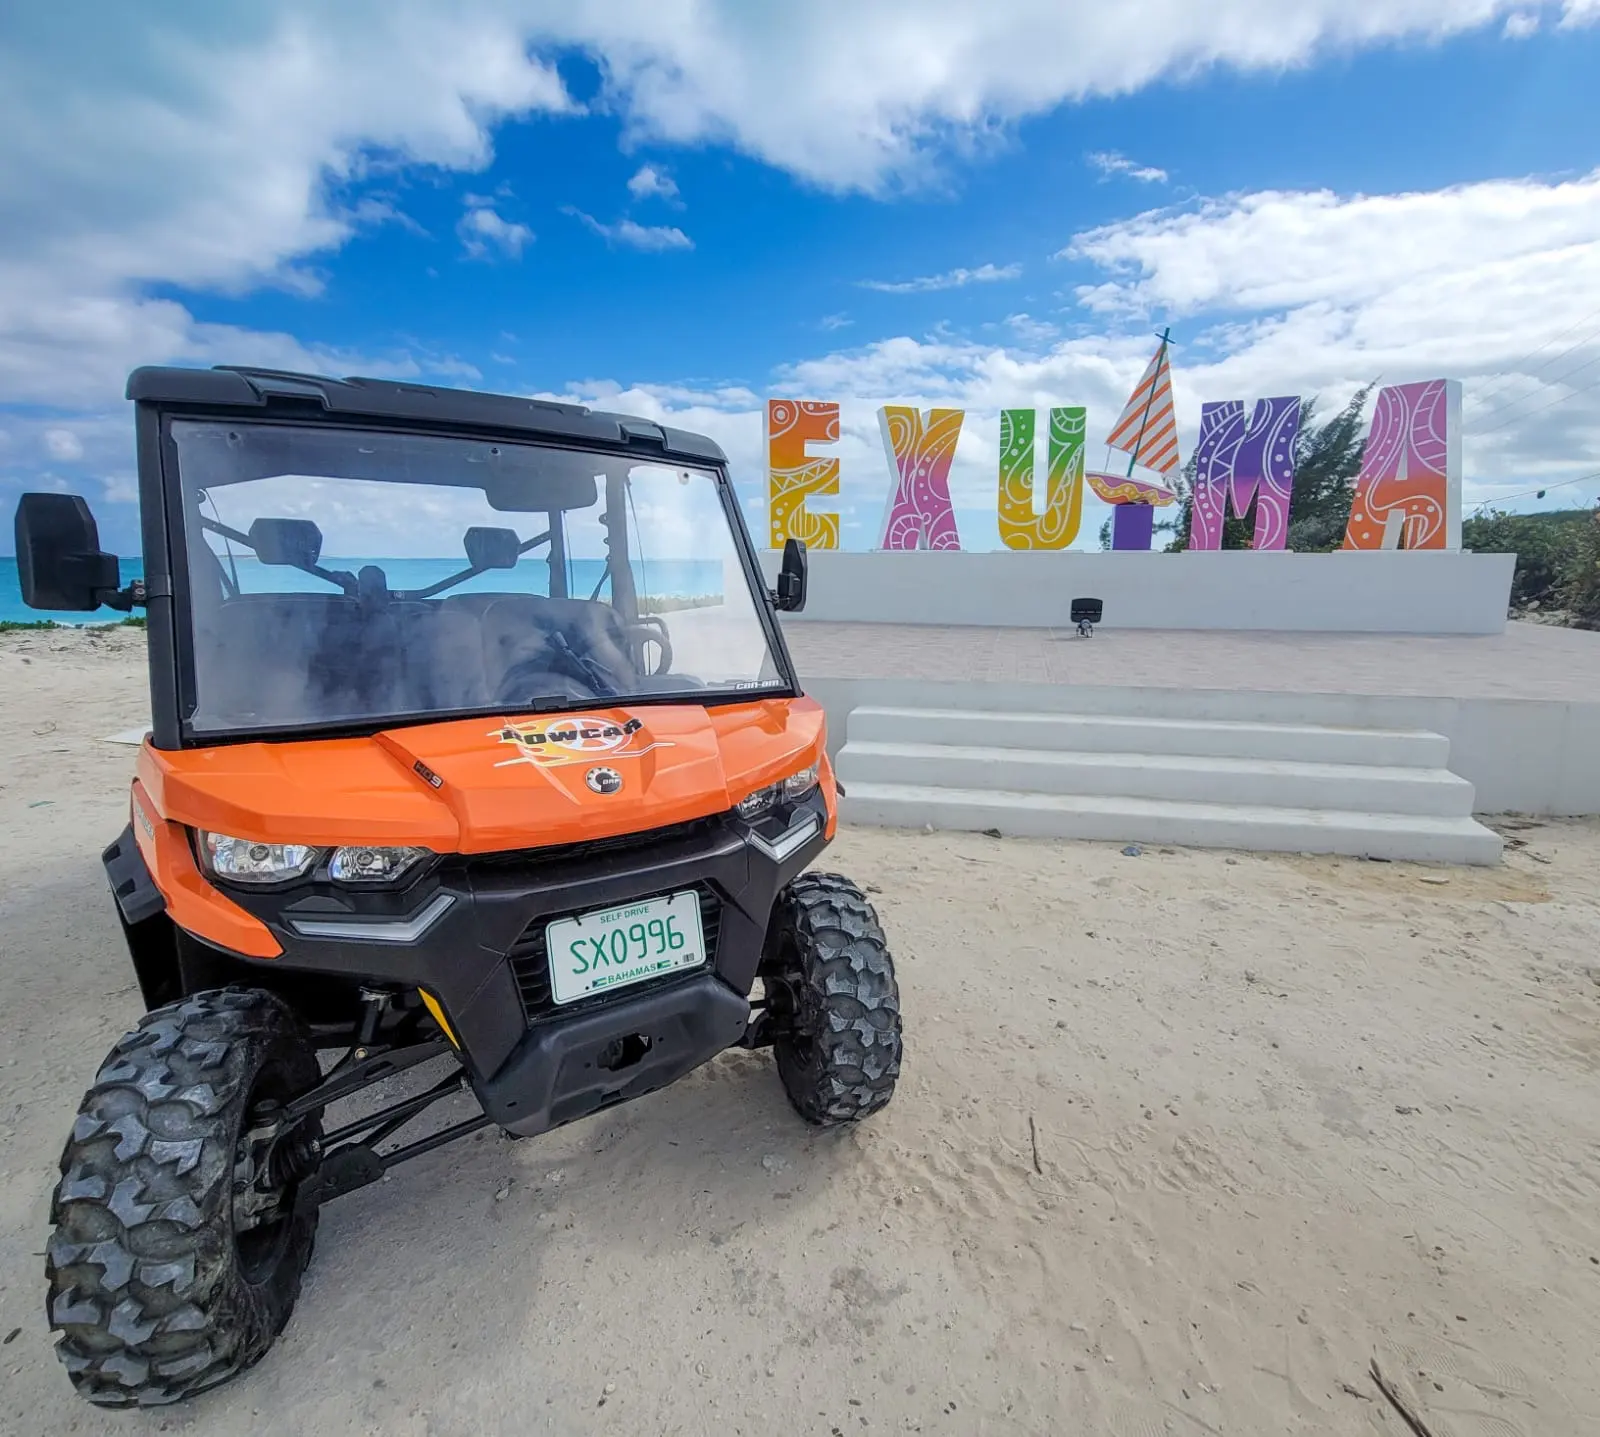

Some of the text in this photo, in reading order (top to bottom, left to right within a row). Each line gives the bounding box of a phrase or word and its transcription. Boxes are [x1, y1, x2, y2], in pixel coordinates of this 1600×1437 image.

[764, 379, 1461, 551] EXUMA
[600, 906, 650, 924] SELF DRIVE
[570, 915, 684, 975] SX0996
[607, 962, 657, 984] BAHAMAS
